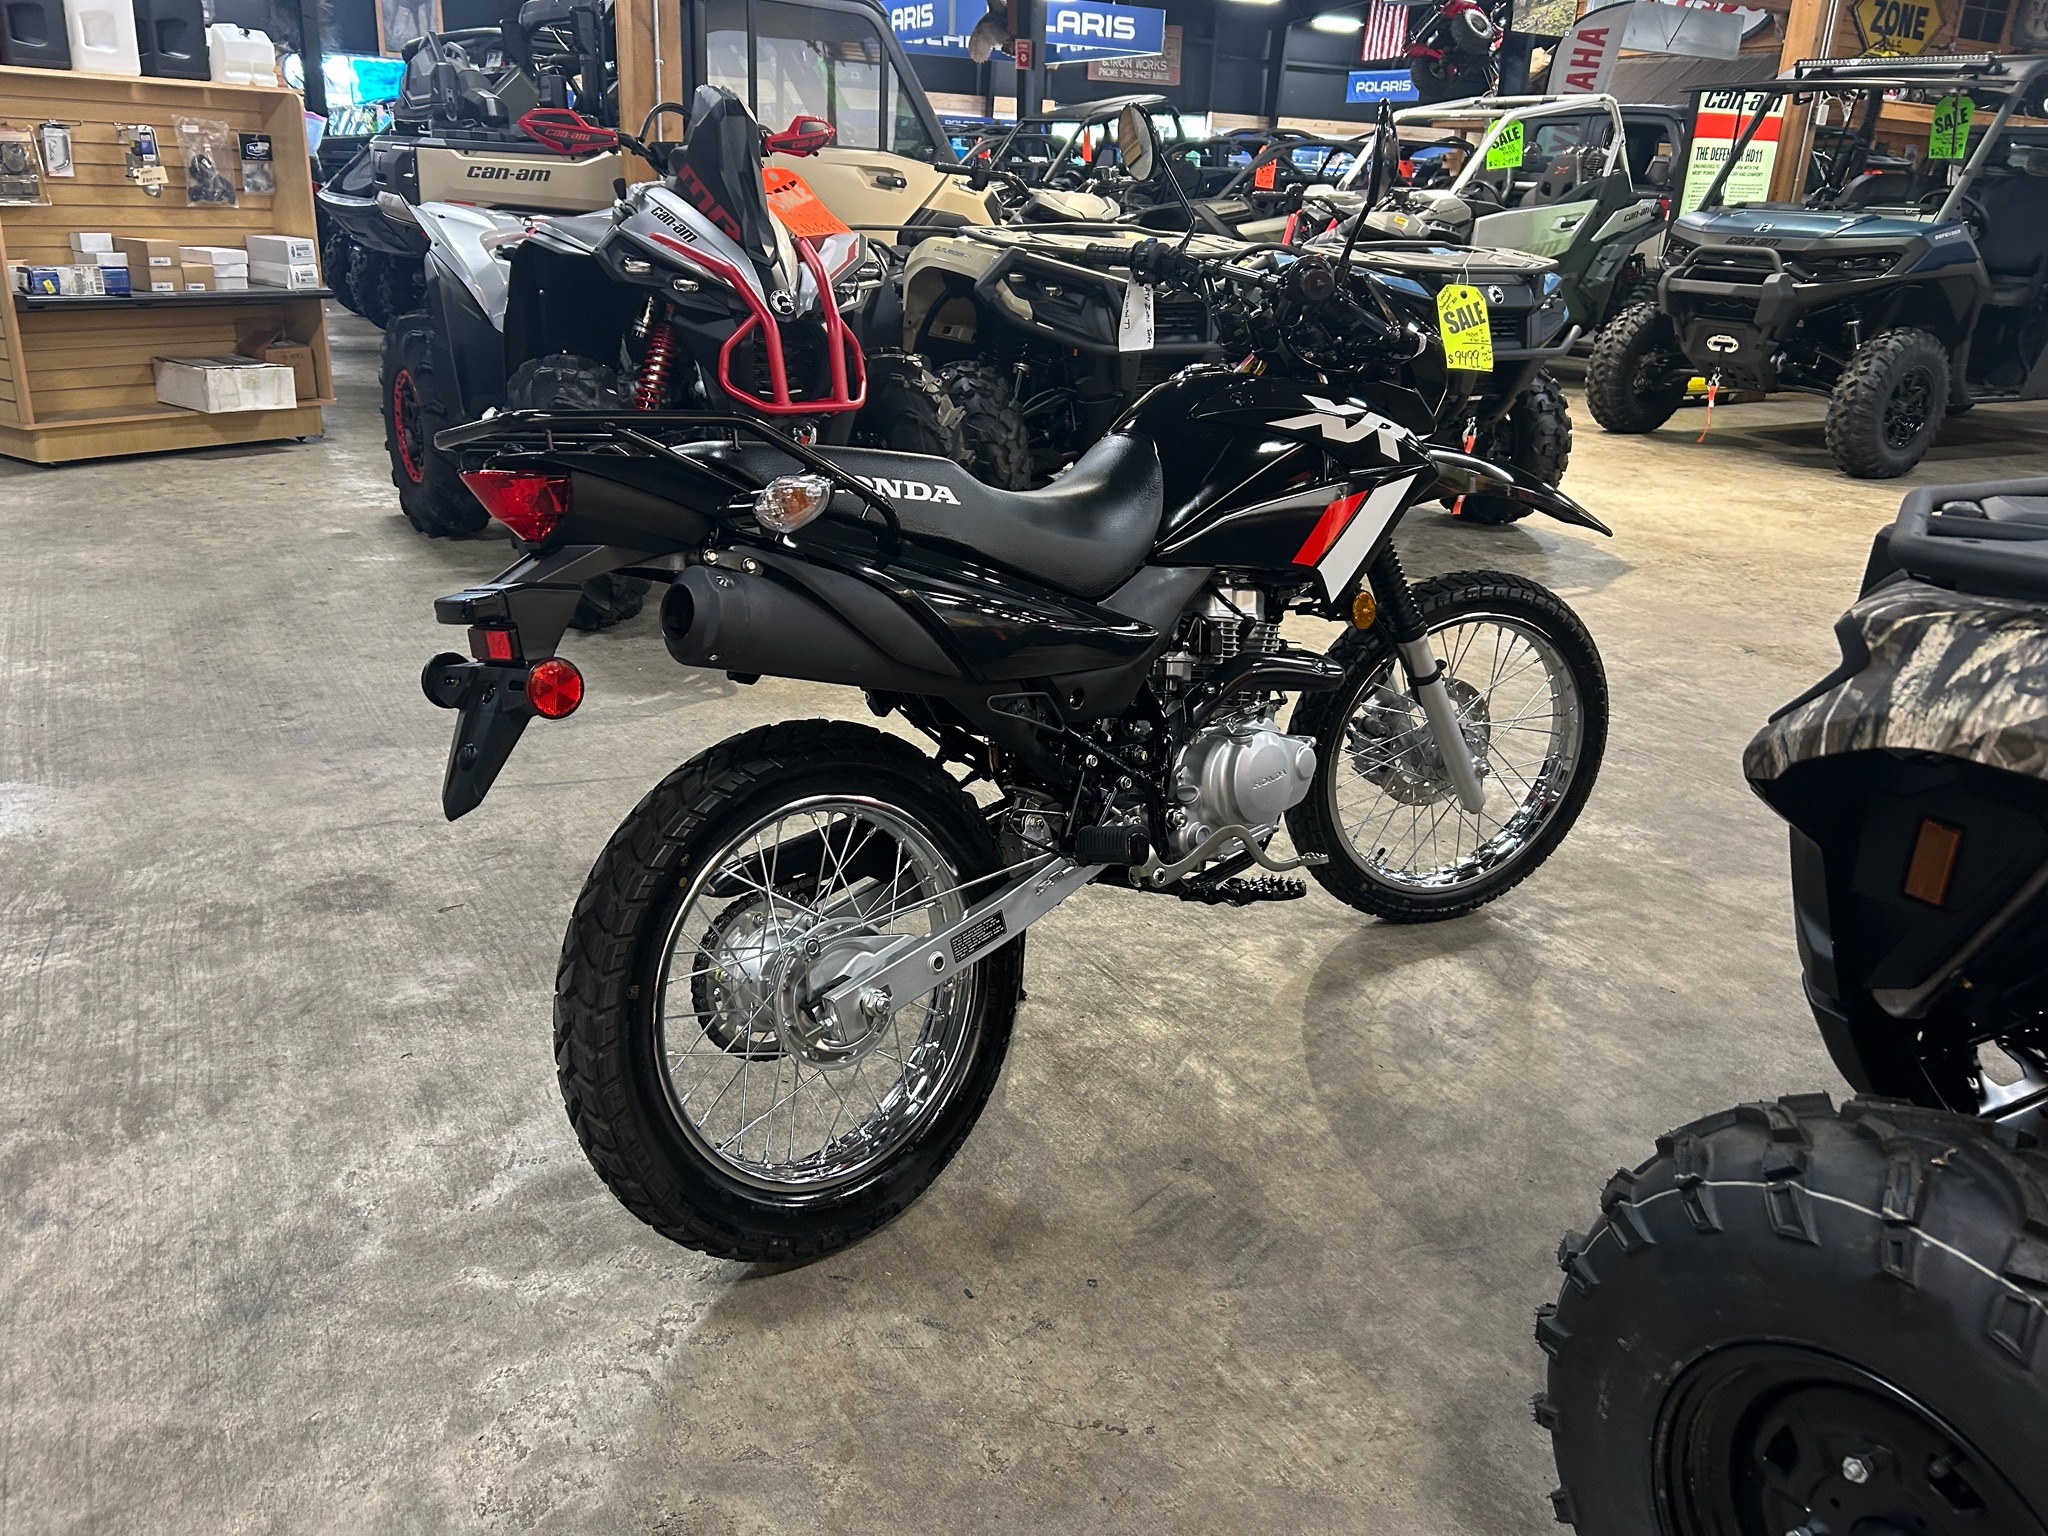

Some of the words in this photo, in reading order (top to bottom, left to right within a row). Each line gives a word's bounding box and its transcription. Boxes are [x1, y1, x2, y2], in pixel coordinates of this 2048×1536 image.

[1870, 0, 1929, 40] ZONE
[1109, 58, 1133, 69] IRON
[1135, 59, 1168, 71] WORKS
[1561, 28, 1610, 94] AHA
[1356, 80, 1411, 93] POLARIS
[544, 127, 591, 142] can-am
[792, 138, 824, 148] can-am
[1491, 126, 1521, 149] SALE
[1695, 147, 1710, 161] THE
[1745, 149, 1764, 163] HD11
[466, 165, 551, 182] can-am
[650, 205, 699, 244] can-am
[1726, 236, 1782, 246] can-am
[1443, 301, 1487, 335] SALE
[853, 475, 962, 506] NDA
[1252, 769, 1288, 790] HONDA
